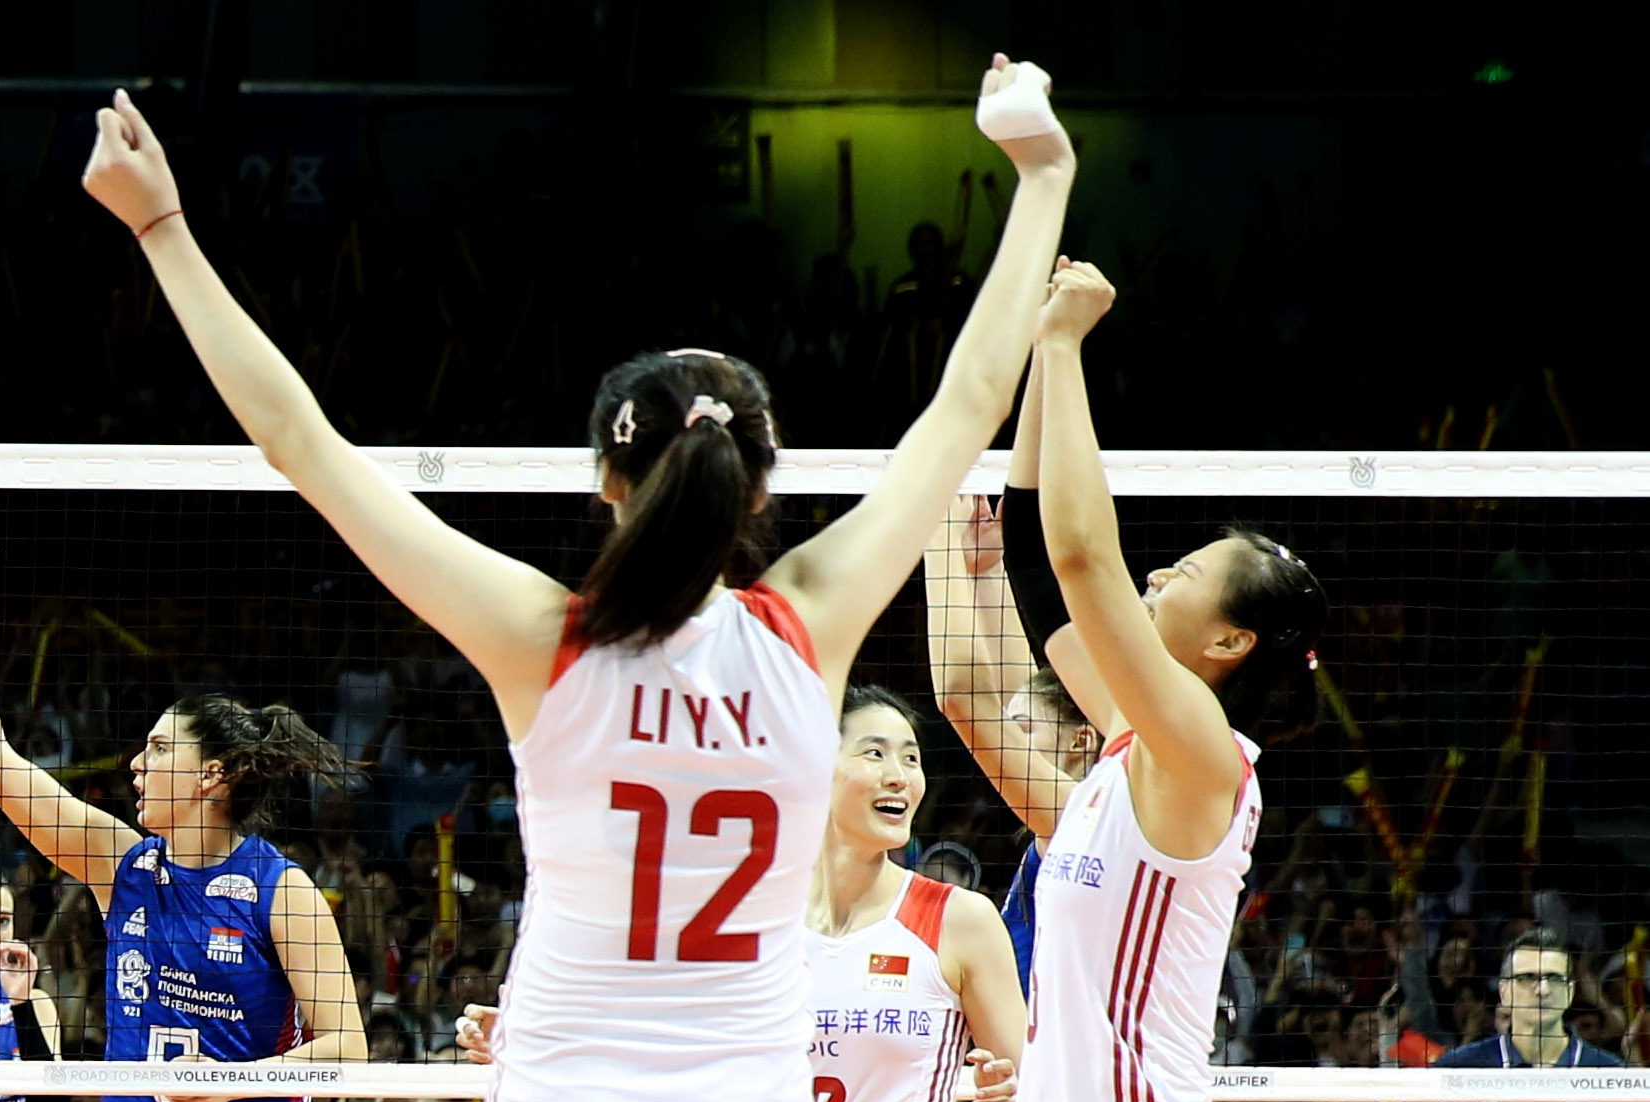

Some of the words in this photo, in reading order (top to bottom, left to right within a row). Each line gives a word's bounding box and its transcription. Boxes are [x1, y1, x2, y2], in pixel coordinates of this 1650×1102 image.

[630, 684, 671, 744] LI
[610, 780, 779, 962] 12
[160, 965, 197, 985] БАНКА
[870, 977, 902, 988] CHN
[158, 979, 235, 1006] ПОШТАНСКА
[70, 1069, 107, 1082] ROAD
[111, 1069, 128, 1082] TO
[133, 1070, 171, 1082] PARIS
[174, 1070, 263, 1083] VOLLEYBALL
[266, 1070, 338, 1083] QUALIFIER
